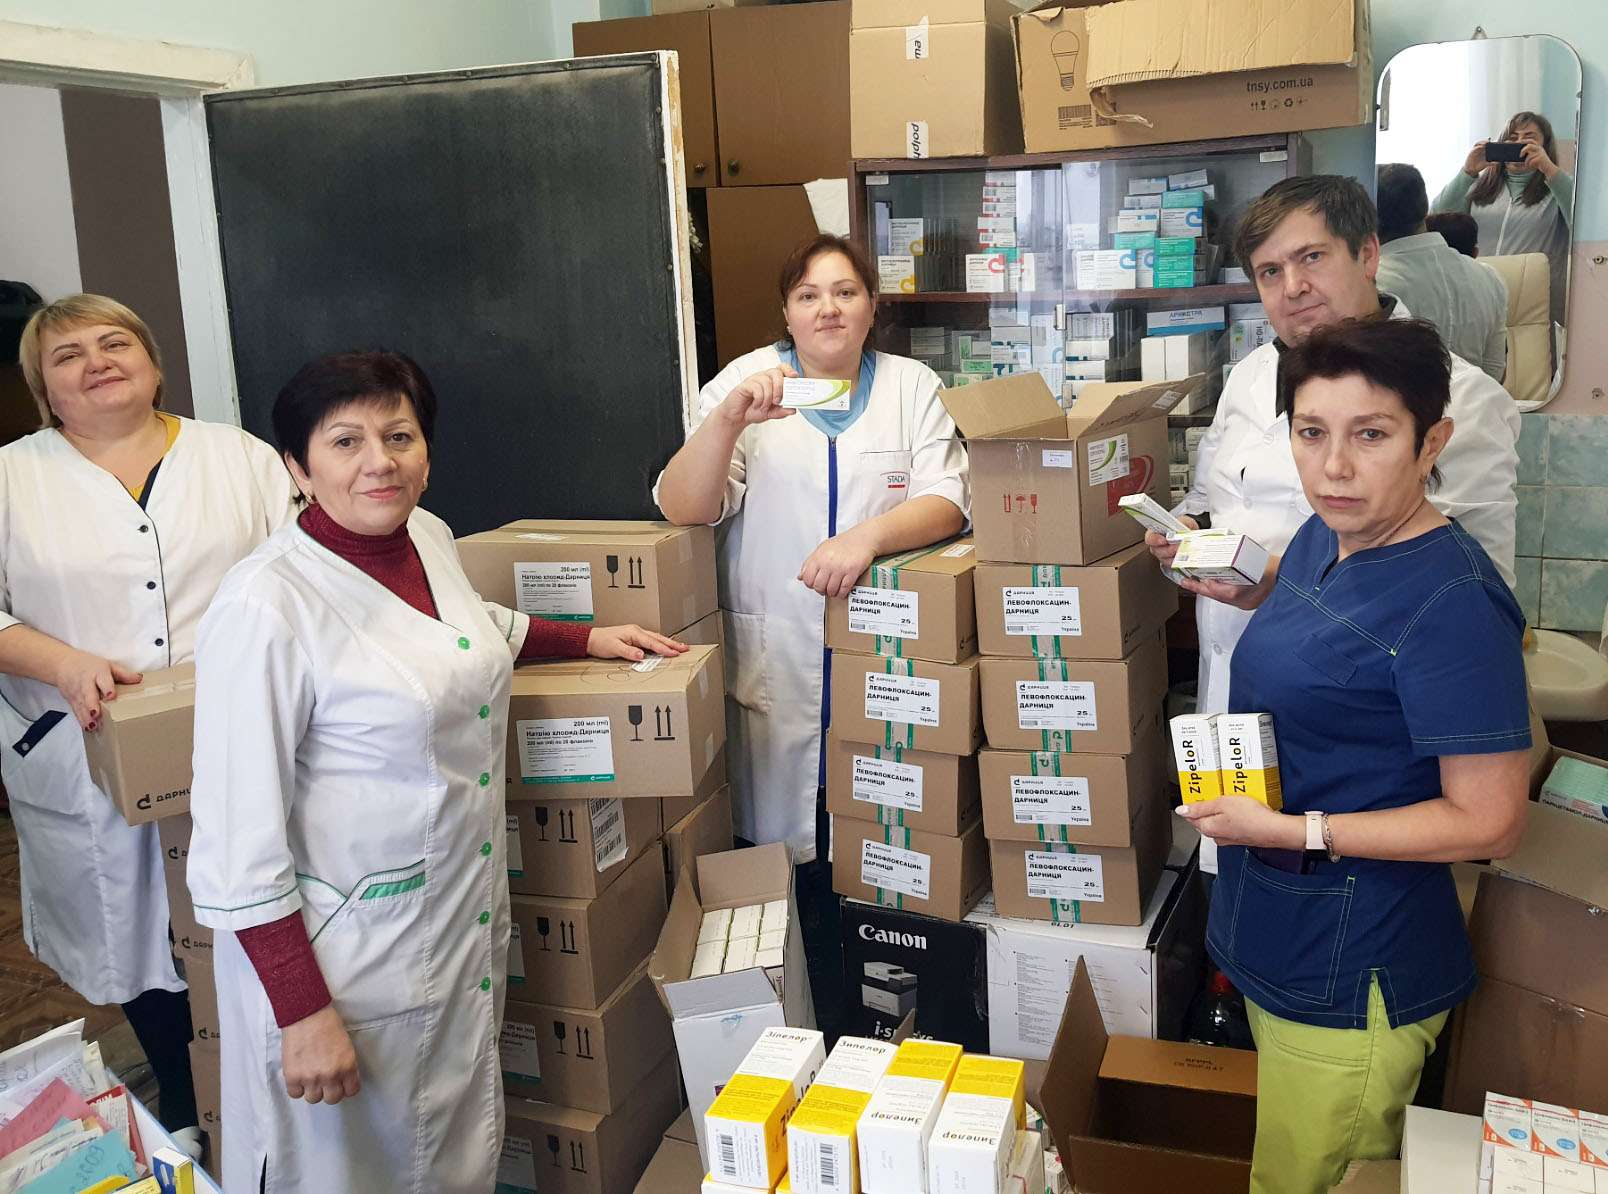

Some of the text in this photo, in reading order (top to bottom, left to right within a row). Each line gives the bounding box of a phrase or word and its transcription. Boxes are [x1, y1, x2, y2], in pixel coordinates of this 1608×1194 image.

[1246, 77, 1313, 93] tnsy.com.ua
[887, 475, 905, 483] STADA
[852, 598, 911, 608] ЛЕВОФЛОКСАЦИН-
[850, 606, 880, 614] ДАРНИЦЯ
[869, 685, 932, 697] ЛЕВОФЛОКСАЦИН-
[1182, 740, 1202, 794] ZipeloR
[1229, 737, 1248, 793] ZipeloR
[855, 776, 885, 785] ДАРНИЦЯ
[1030, 863, 1094, 872] ЛЕВОФЛОКСАЦИН-
[858, 924, 926, 950] Canon
[839, 1041, 886, 1054] Зипелор
[871, 1112, 922, 1125] Зипелор
[943, 1131, 997, 1145] Зипелор
